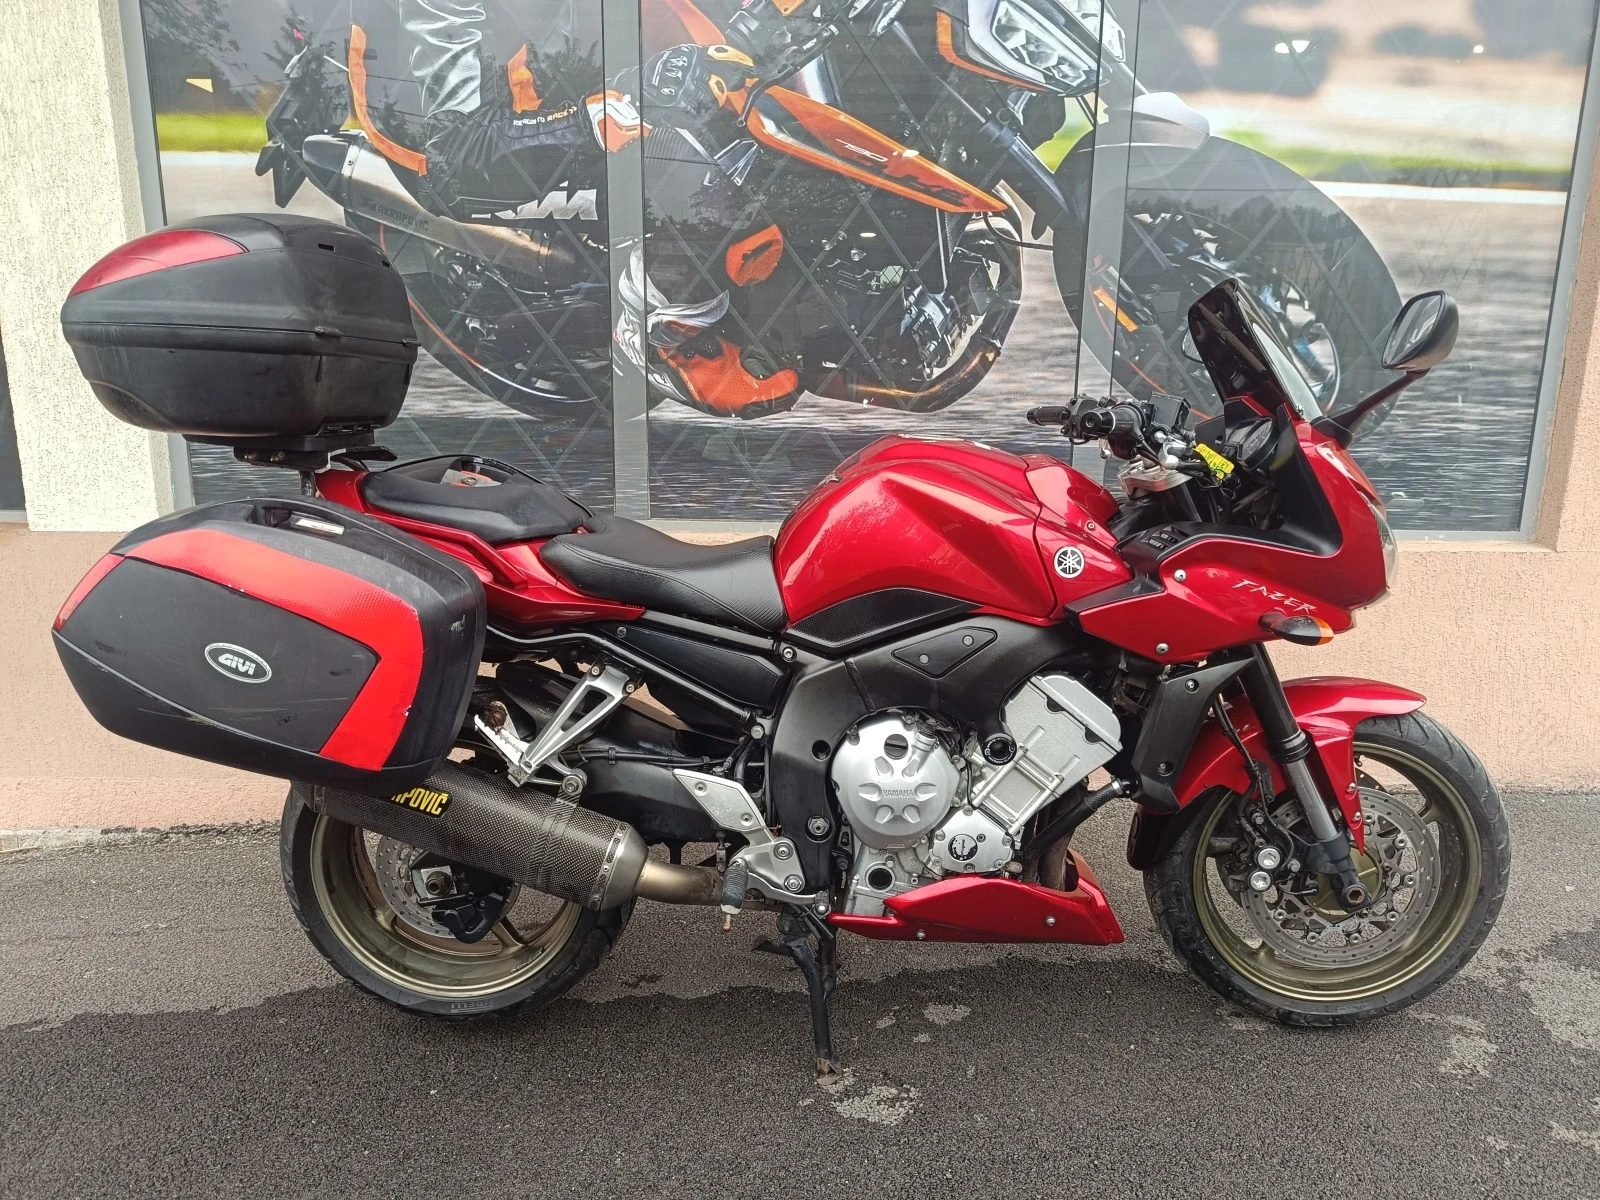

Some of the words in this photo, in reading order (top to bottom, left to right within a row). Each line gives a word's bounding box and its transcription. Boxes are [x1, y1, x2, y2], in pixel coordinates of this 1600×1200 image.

[1231, 578, 1319, 615] FAZER
[217, 653, 257, 676] GIVI
[882, 789, 914, 799] YAMAHA
[450, 1000, 496, 1010] PIRELLI
